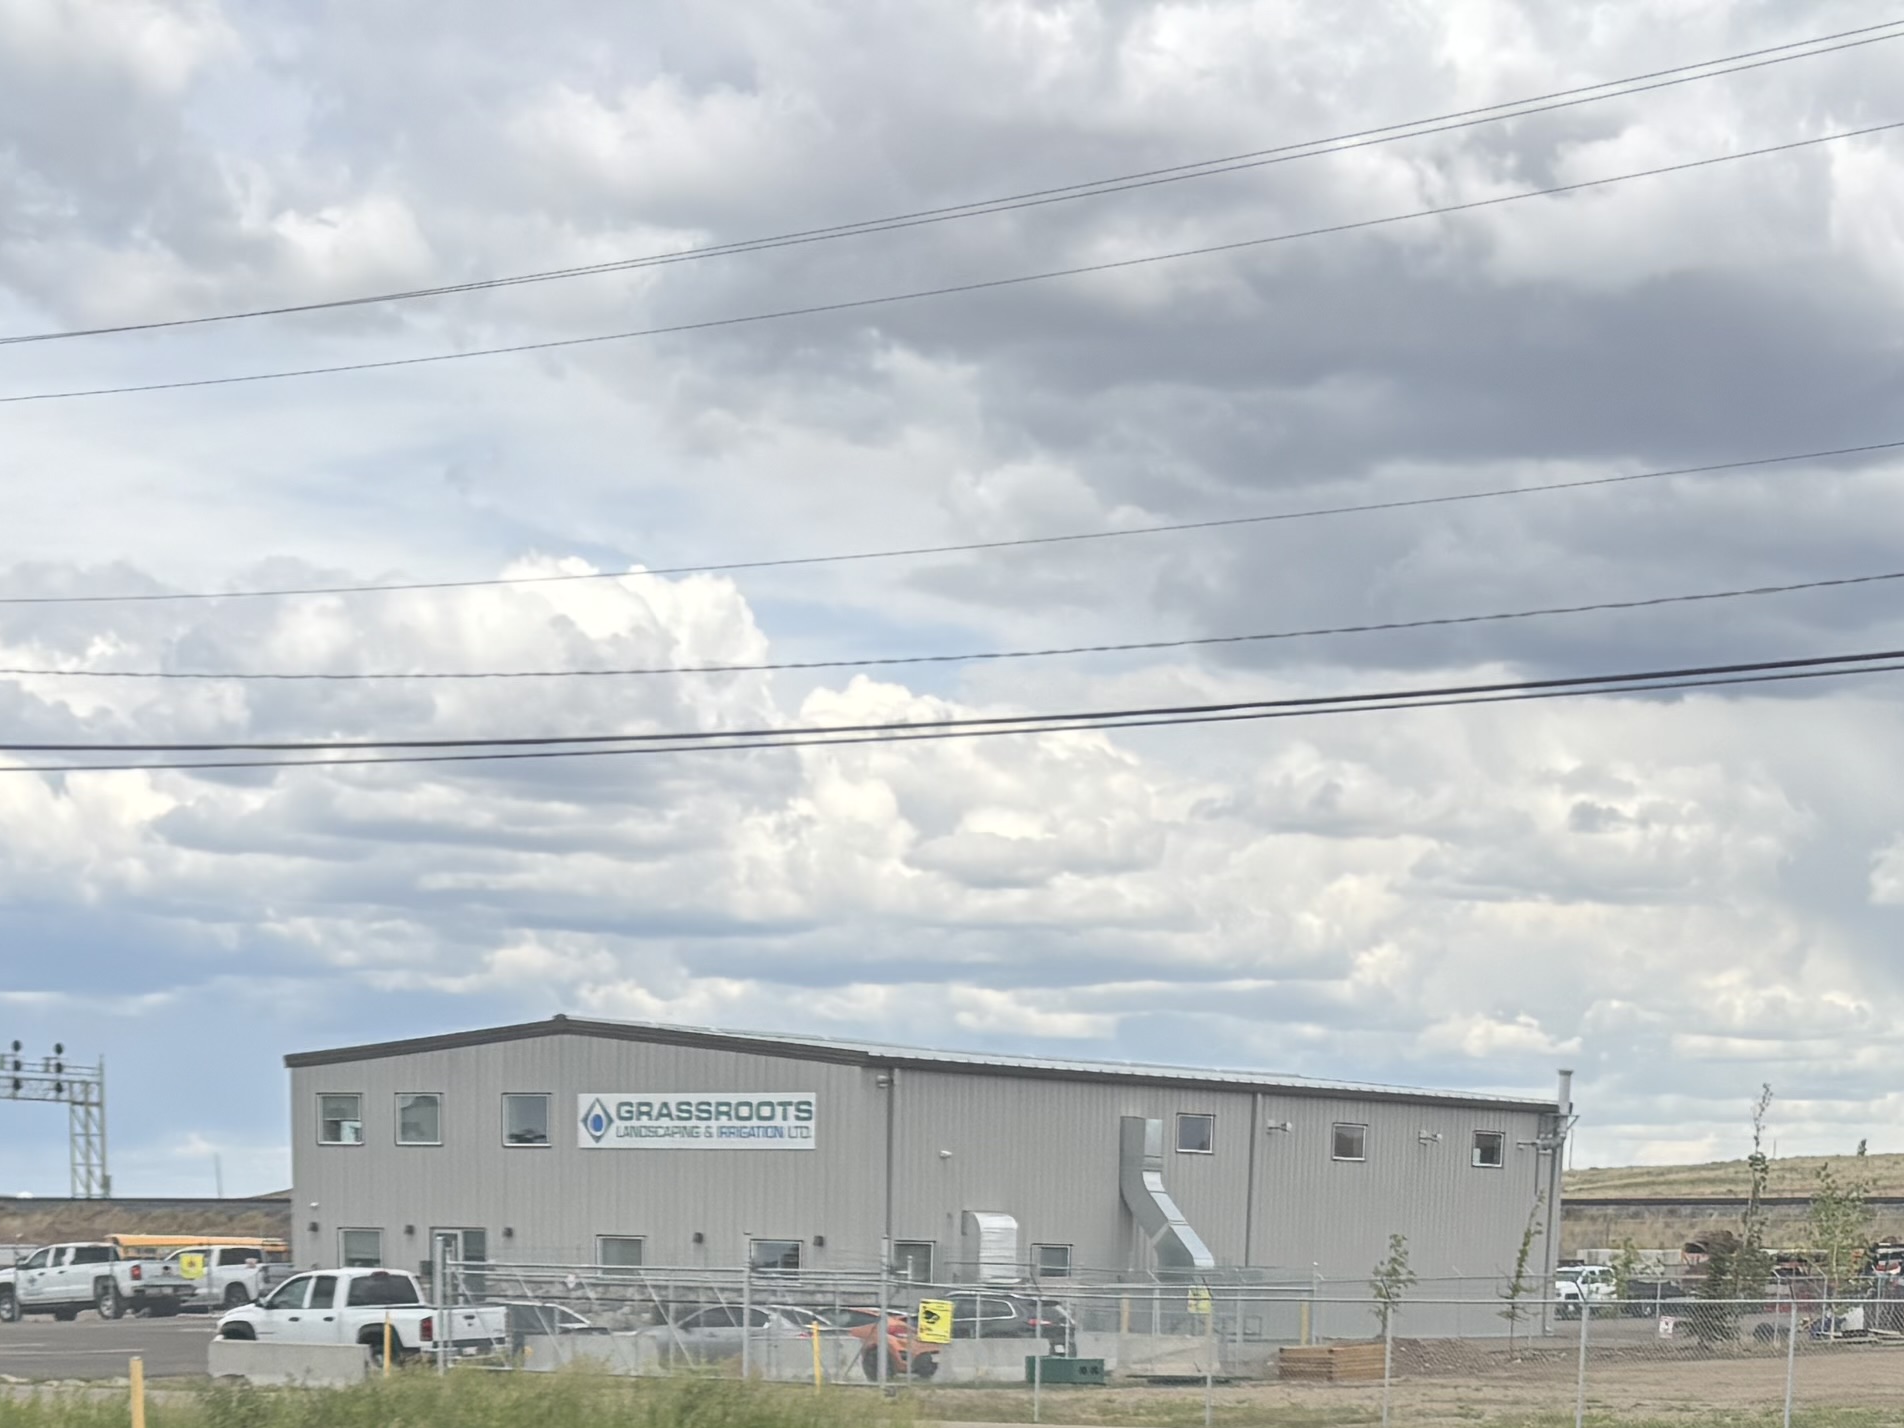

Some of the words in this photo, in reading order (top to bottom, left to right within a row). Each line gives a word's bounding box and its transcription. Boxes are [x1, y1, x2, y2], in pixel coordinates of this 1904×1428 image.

[616, 1100, 814, 1122] GRASSROOTS
[616, 1125, 700, 1139] LANDSCAPING
[704, 1125, 713, 1139] &
[716, 1125, 784, 1139] IRRIGATION
